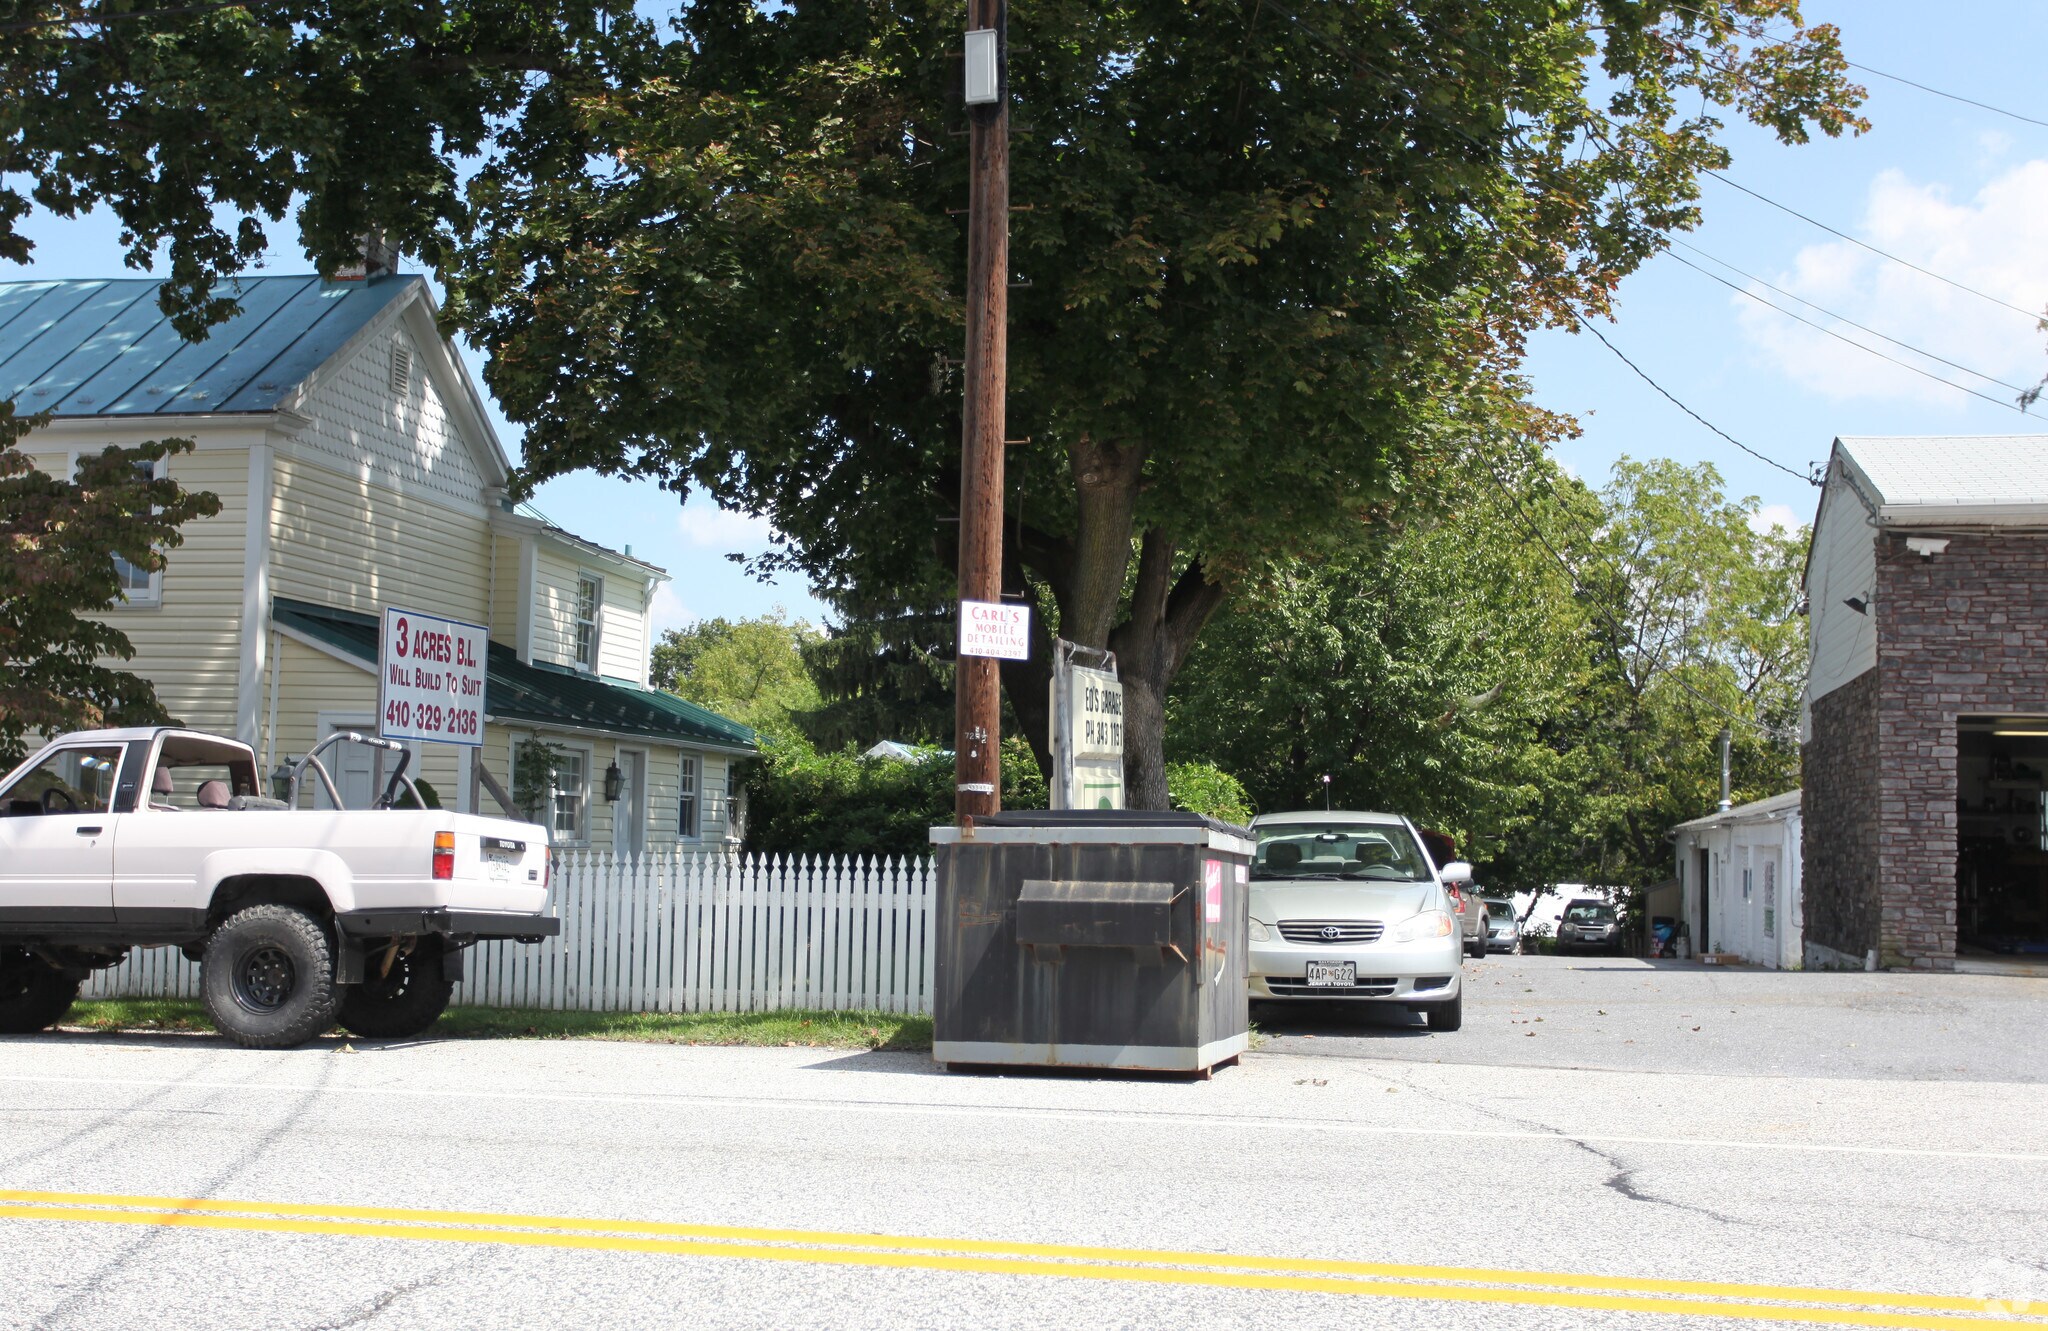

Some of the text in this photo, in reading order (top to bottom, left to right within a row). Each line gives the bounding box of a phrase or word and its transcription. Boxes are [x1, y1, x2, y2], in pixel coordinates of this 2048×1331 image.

[971, 606, 1020, 624] CARL'S
[975, 623, 1015, 636] MOBILE
[396, 617, 477, 668] 3 ACRES B.L.
[967, 633, 1025, 648] DETAILING
[389, 663, 482, 697] WILL BUILD TO SUIT
[1085, 686, 1122, 716] ED'S GARAGE
[498, 839, 516, 851] TOYOTA
